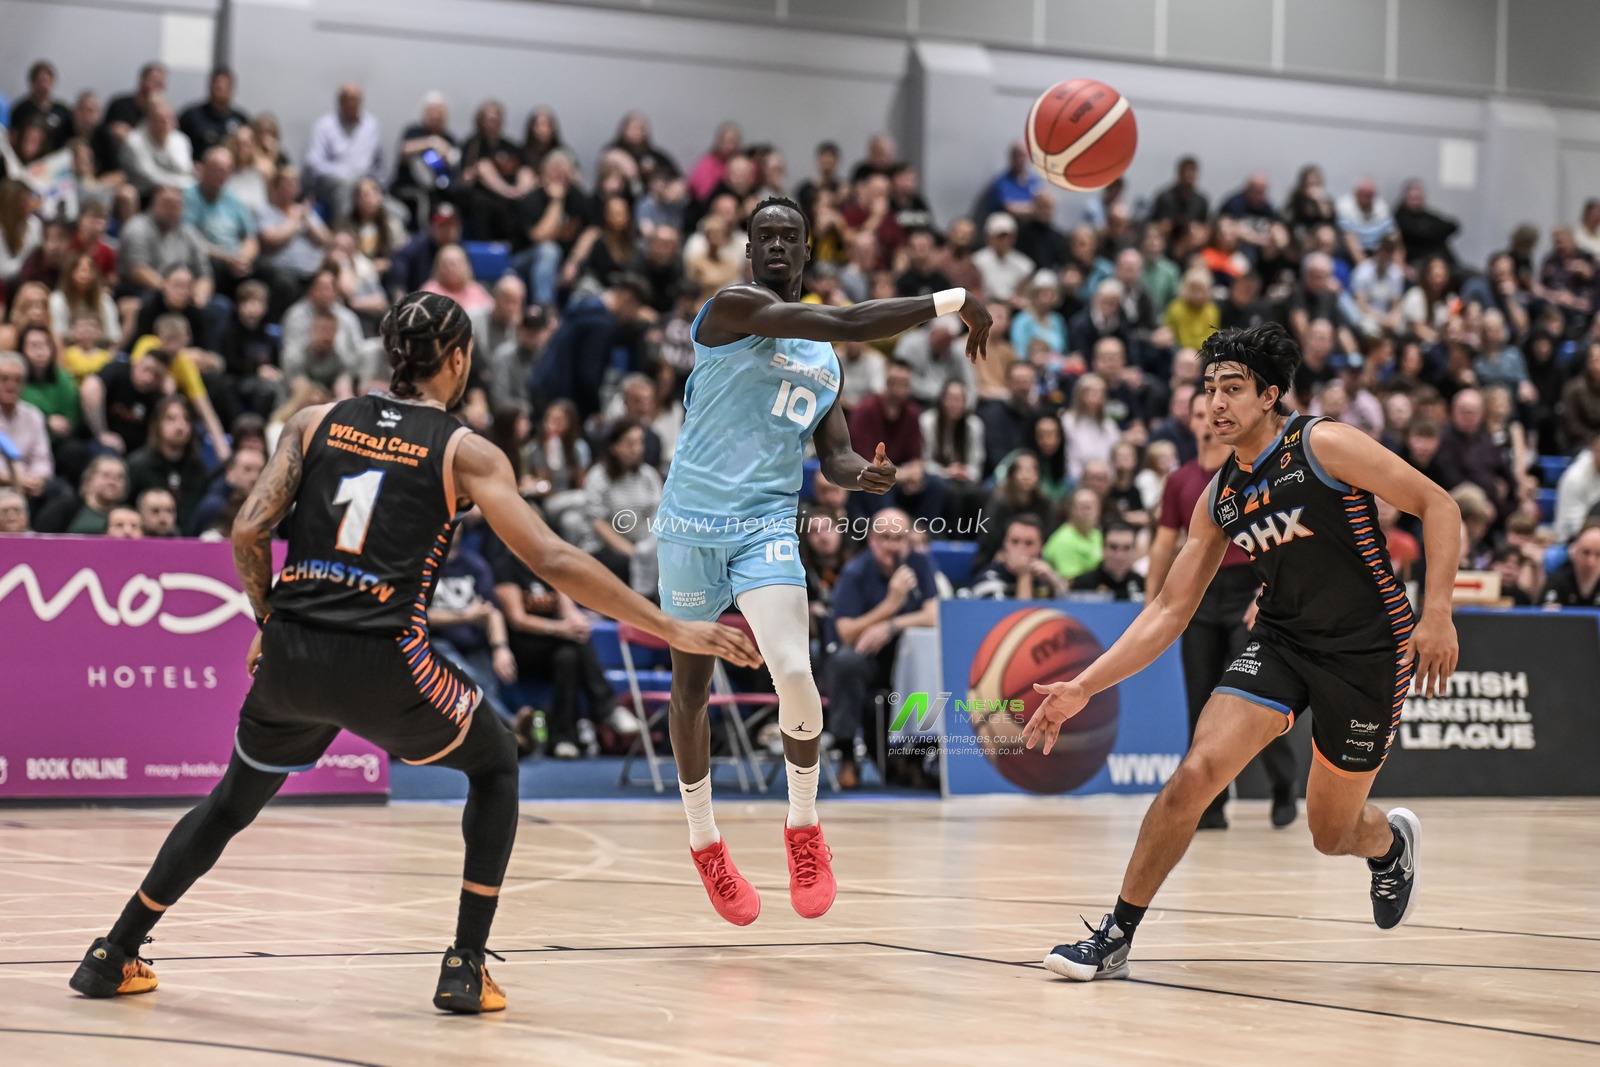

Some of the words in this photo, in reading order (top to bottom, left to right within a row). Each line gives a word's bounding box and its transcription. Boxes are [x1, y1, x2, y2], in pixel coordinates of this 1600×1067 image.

[770, 352, 839, 393] SURREY
[771, 379, 817, 428] 10
[329, 423, 387, 451] Wirral
[387, 437, 429, 458] Cars
[332, 467, 387, 555] 1
[1242, 477, 1271, 515] 21
[765, 540, 795, 564] 10
[1233, 505, 1315, 561] PHX
[281, 559, 396, 603] CHRISTON
[87, 665, 218, 689] HOTELS
[1400, 723, 1536, 749] LEAGUE
[26, 757, 70, 780] BOOK
[71, 757, 128, 780] ONLINE
